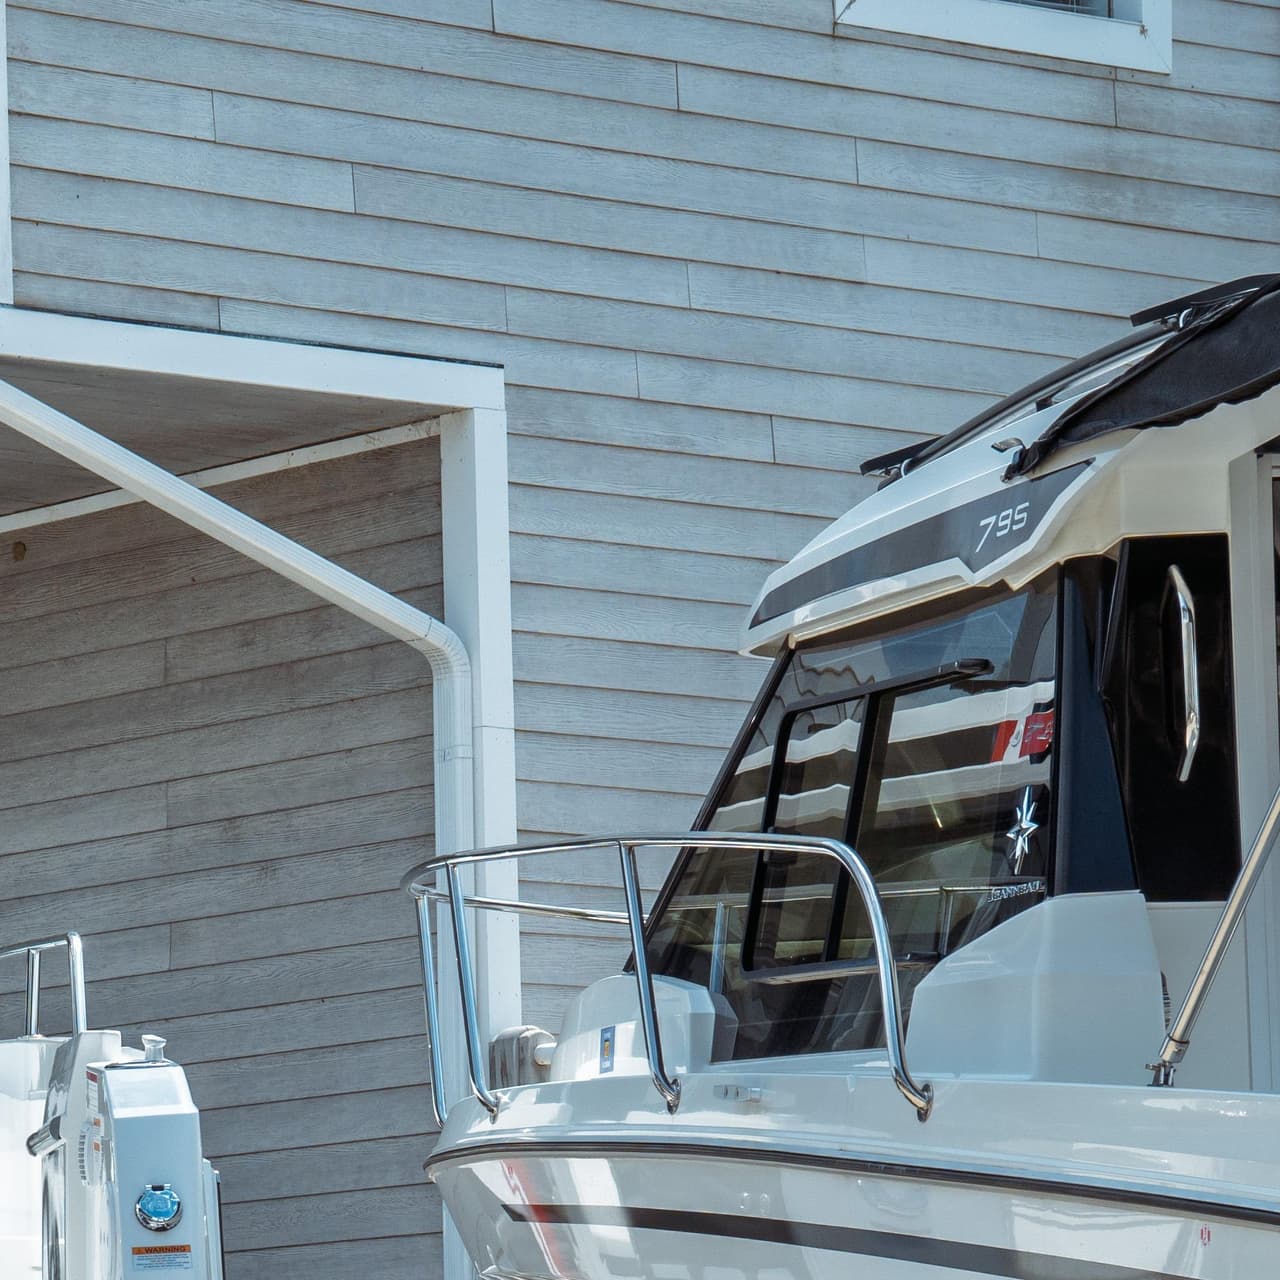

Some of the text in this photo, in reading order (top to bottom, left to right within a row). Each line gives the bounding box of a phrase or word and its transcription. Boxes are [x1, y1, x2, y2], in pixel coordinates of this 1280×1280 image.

[975, 502, 1030, 553] 795
[987, 880, 1043, 902] JEANNEAU
[144, 1245, 186, 1255] WARNING
